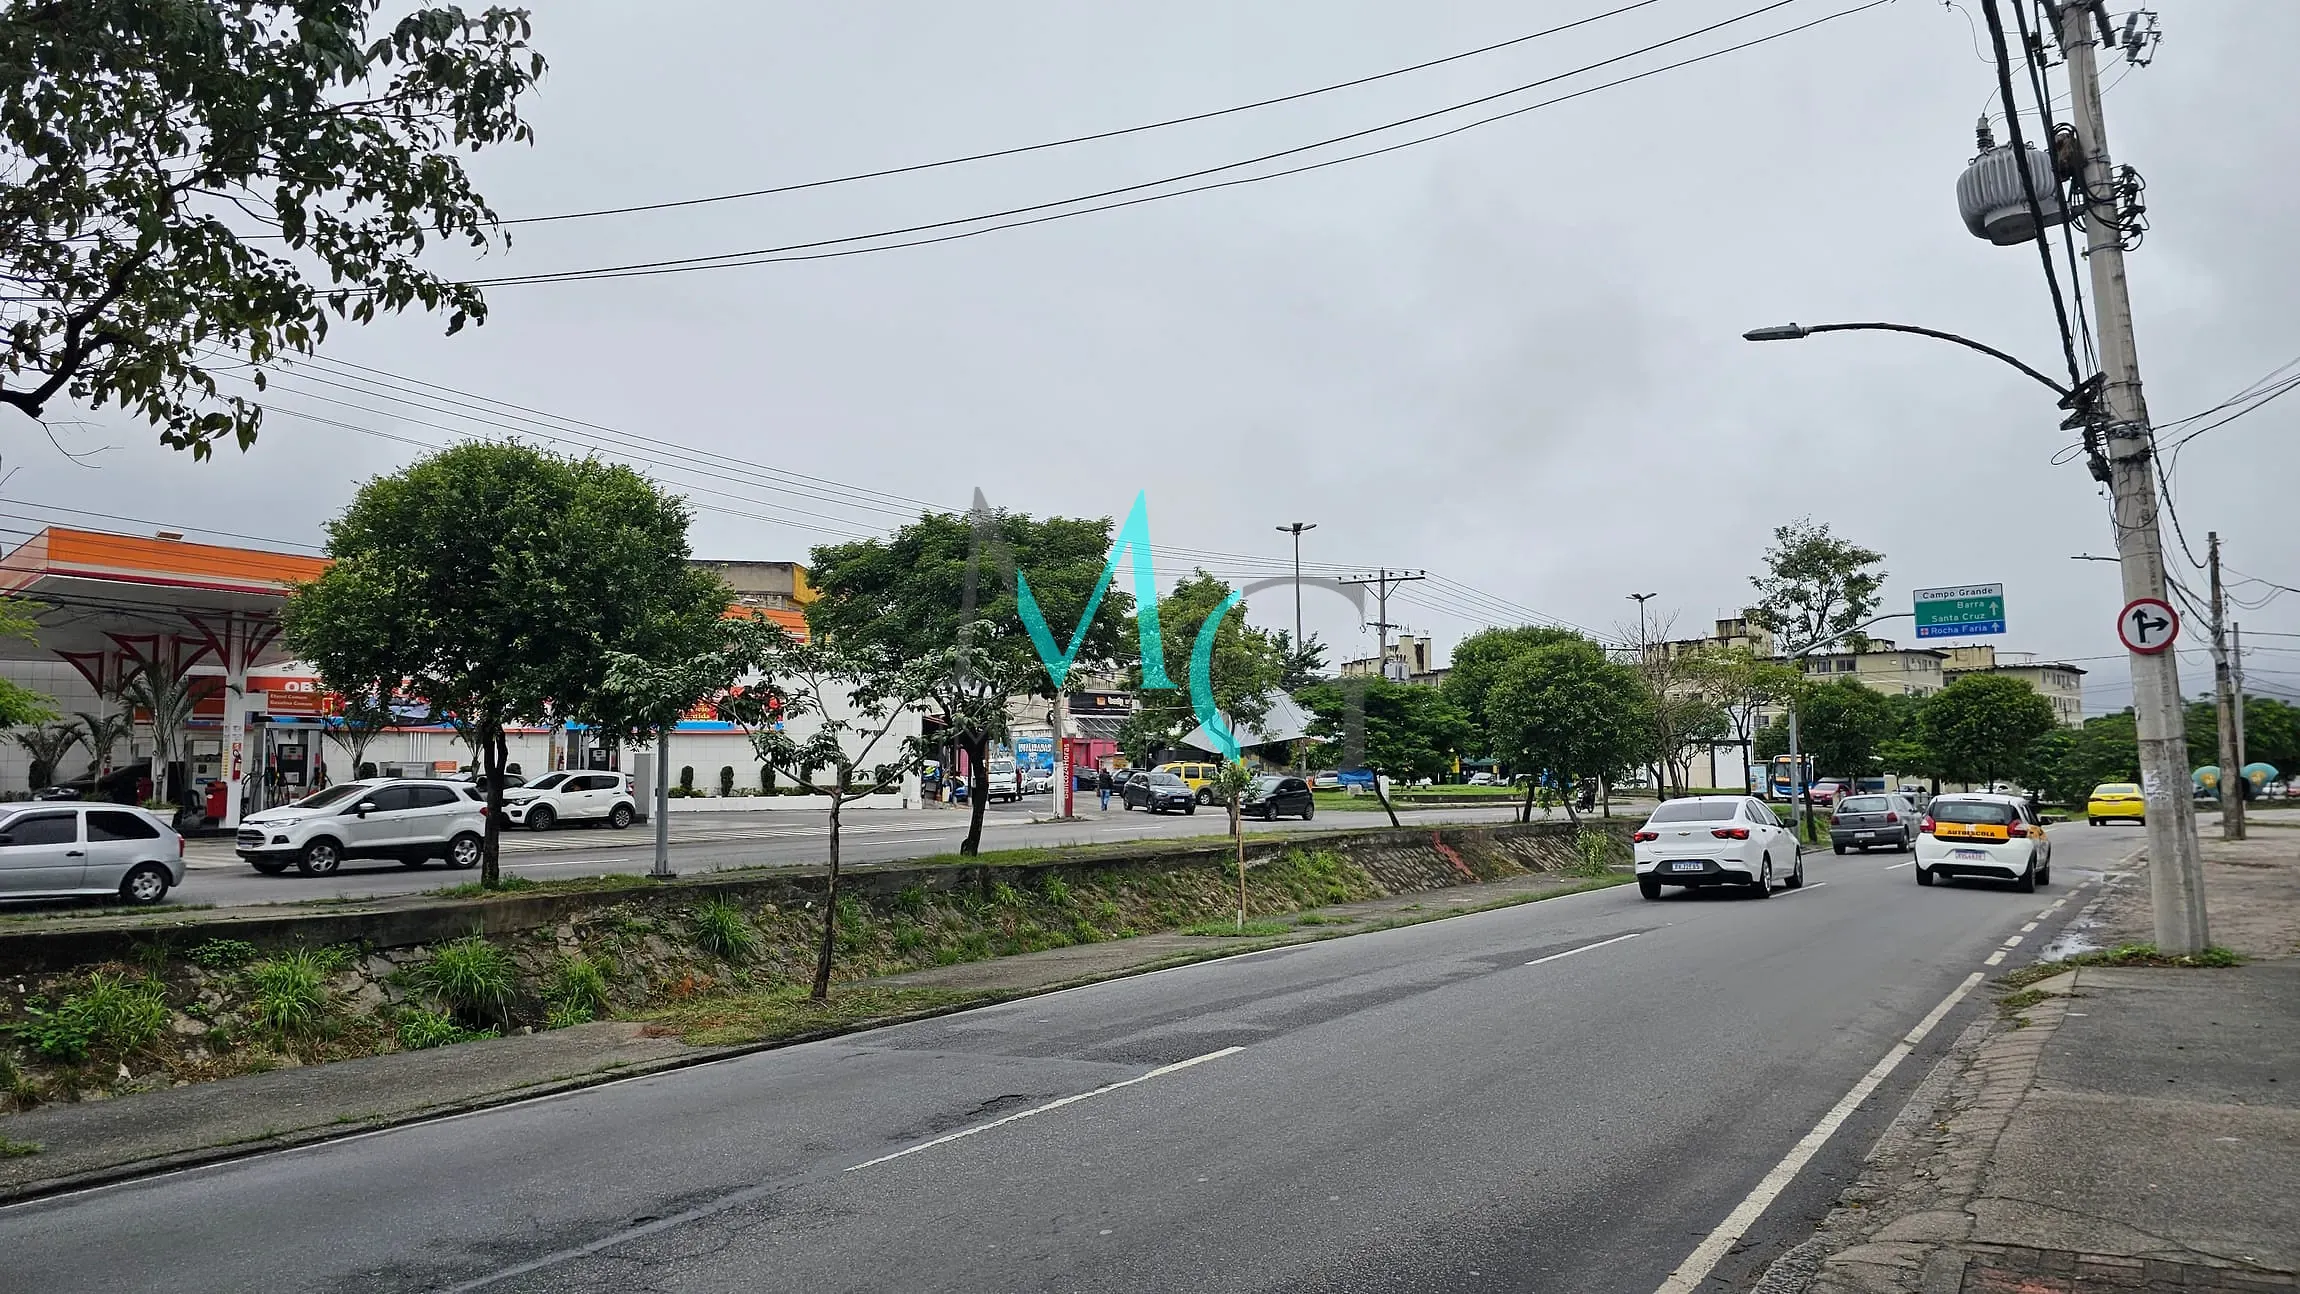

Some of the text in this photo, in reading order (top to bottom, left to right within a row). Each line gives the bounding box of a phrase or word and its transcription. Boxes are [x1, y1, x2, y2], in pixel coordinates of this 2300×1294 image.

[1922, 587, 1993, 600] Campo Grande
[1956, 601, 1985, 609] Barra
[1931, 613, 1985, 623] Santa Cruz
[1930, 624, 1988, 635] Rocha Faria
